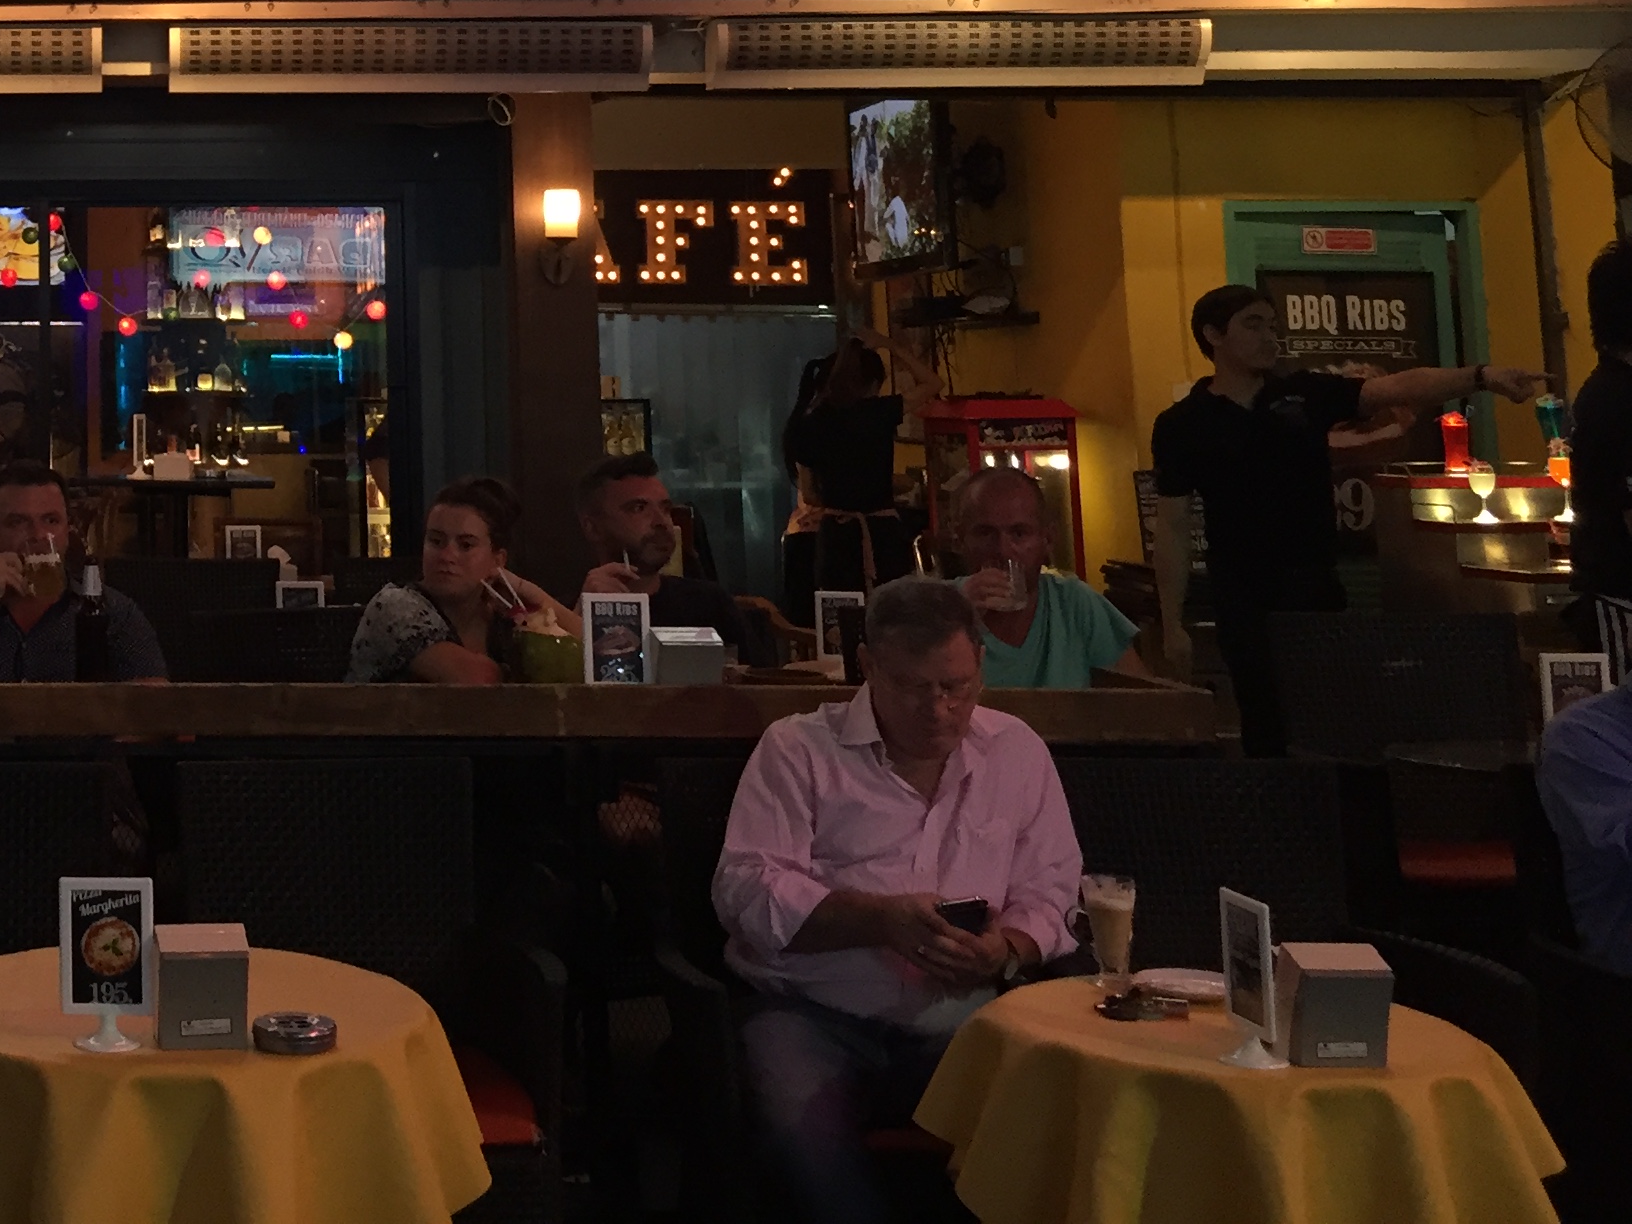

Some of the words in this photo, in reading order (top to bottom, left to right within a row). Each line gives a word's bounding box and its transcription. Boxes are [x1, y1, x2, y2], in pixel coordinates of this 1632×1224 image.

[1286, 294, 1338, 335] BBQ
[1292, 340, 1395, 351] SPECIALS
[79, 893, 141, 916] Margherita
